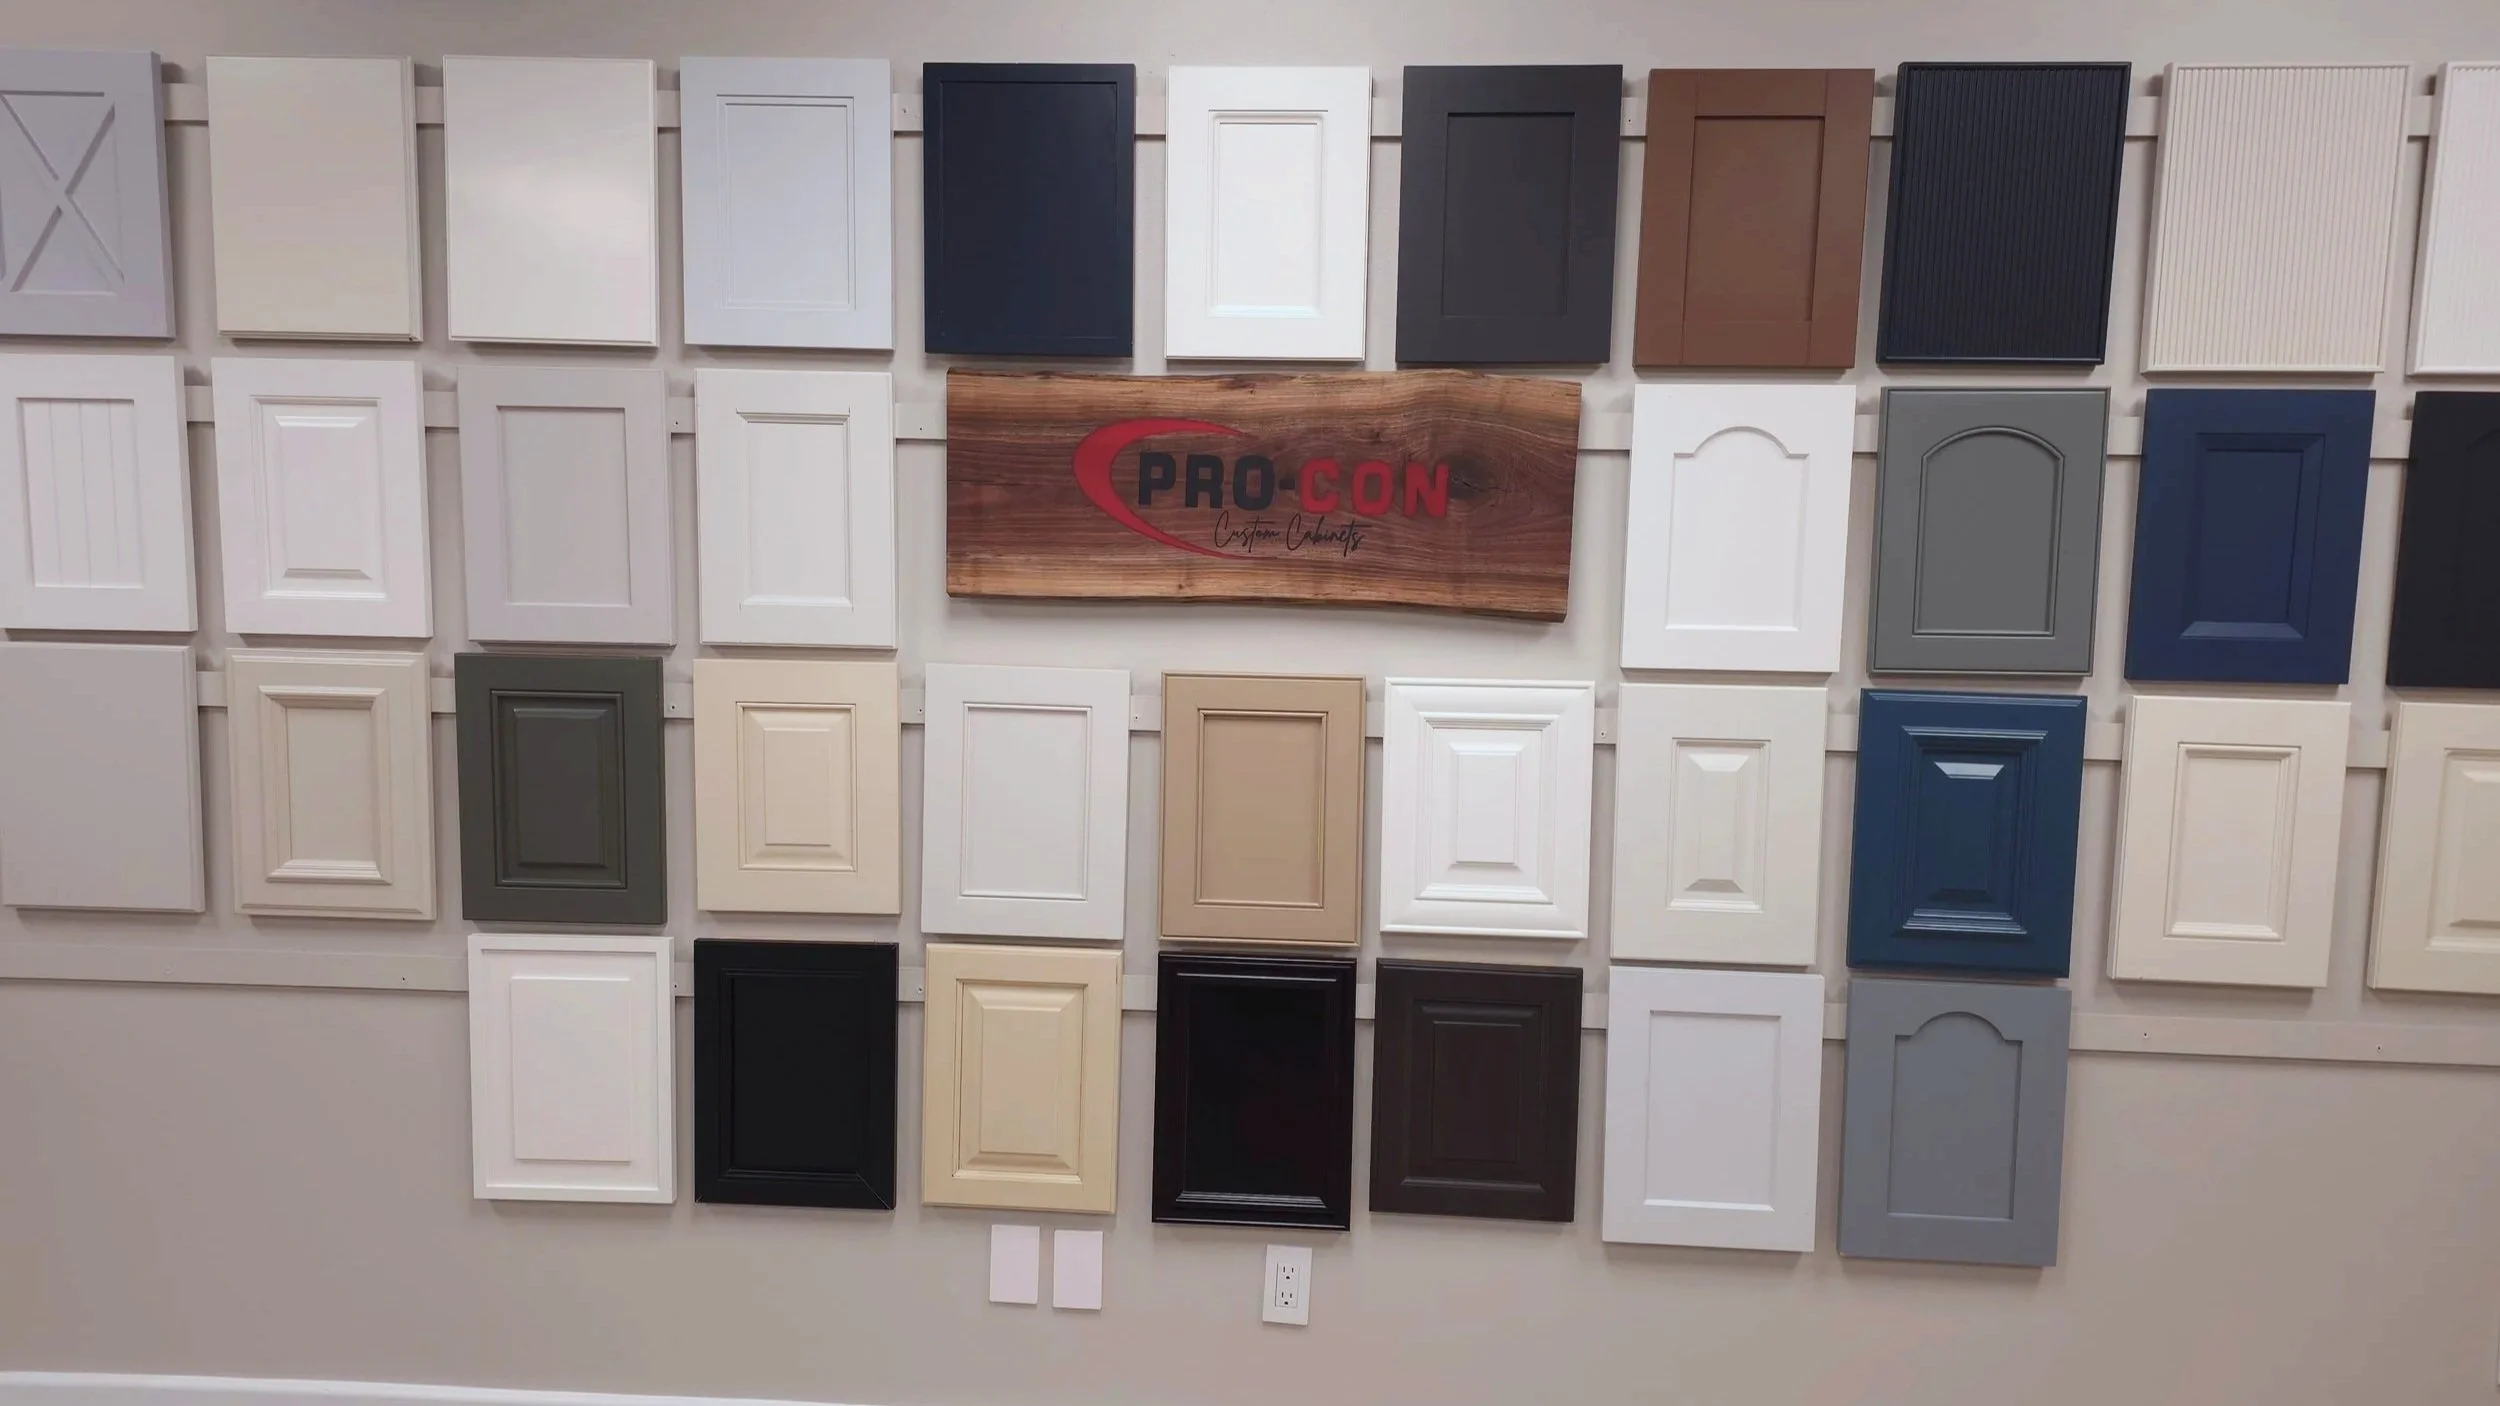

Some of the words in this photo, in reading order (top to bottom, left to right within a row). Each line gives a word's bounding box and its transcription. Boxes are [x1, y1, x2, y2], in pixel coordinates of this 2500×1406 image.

[1137, 451, 1450, 518] PRO-CON
[1213, 510, 1280, 553] Custom
[1285, 514, 1373, 557] Cabinets
